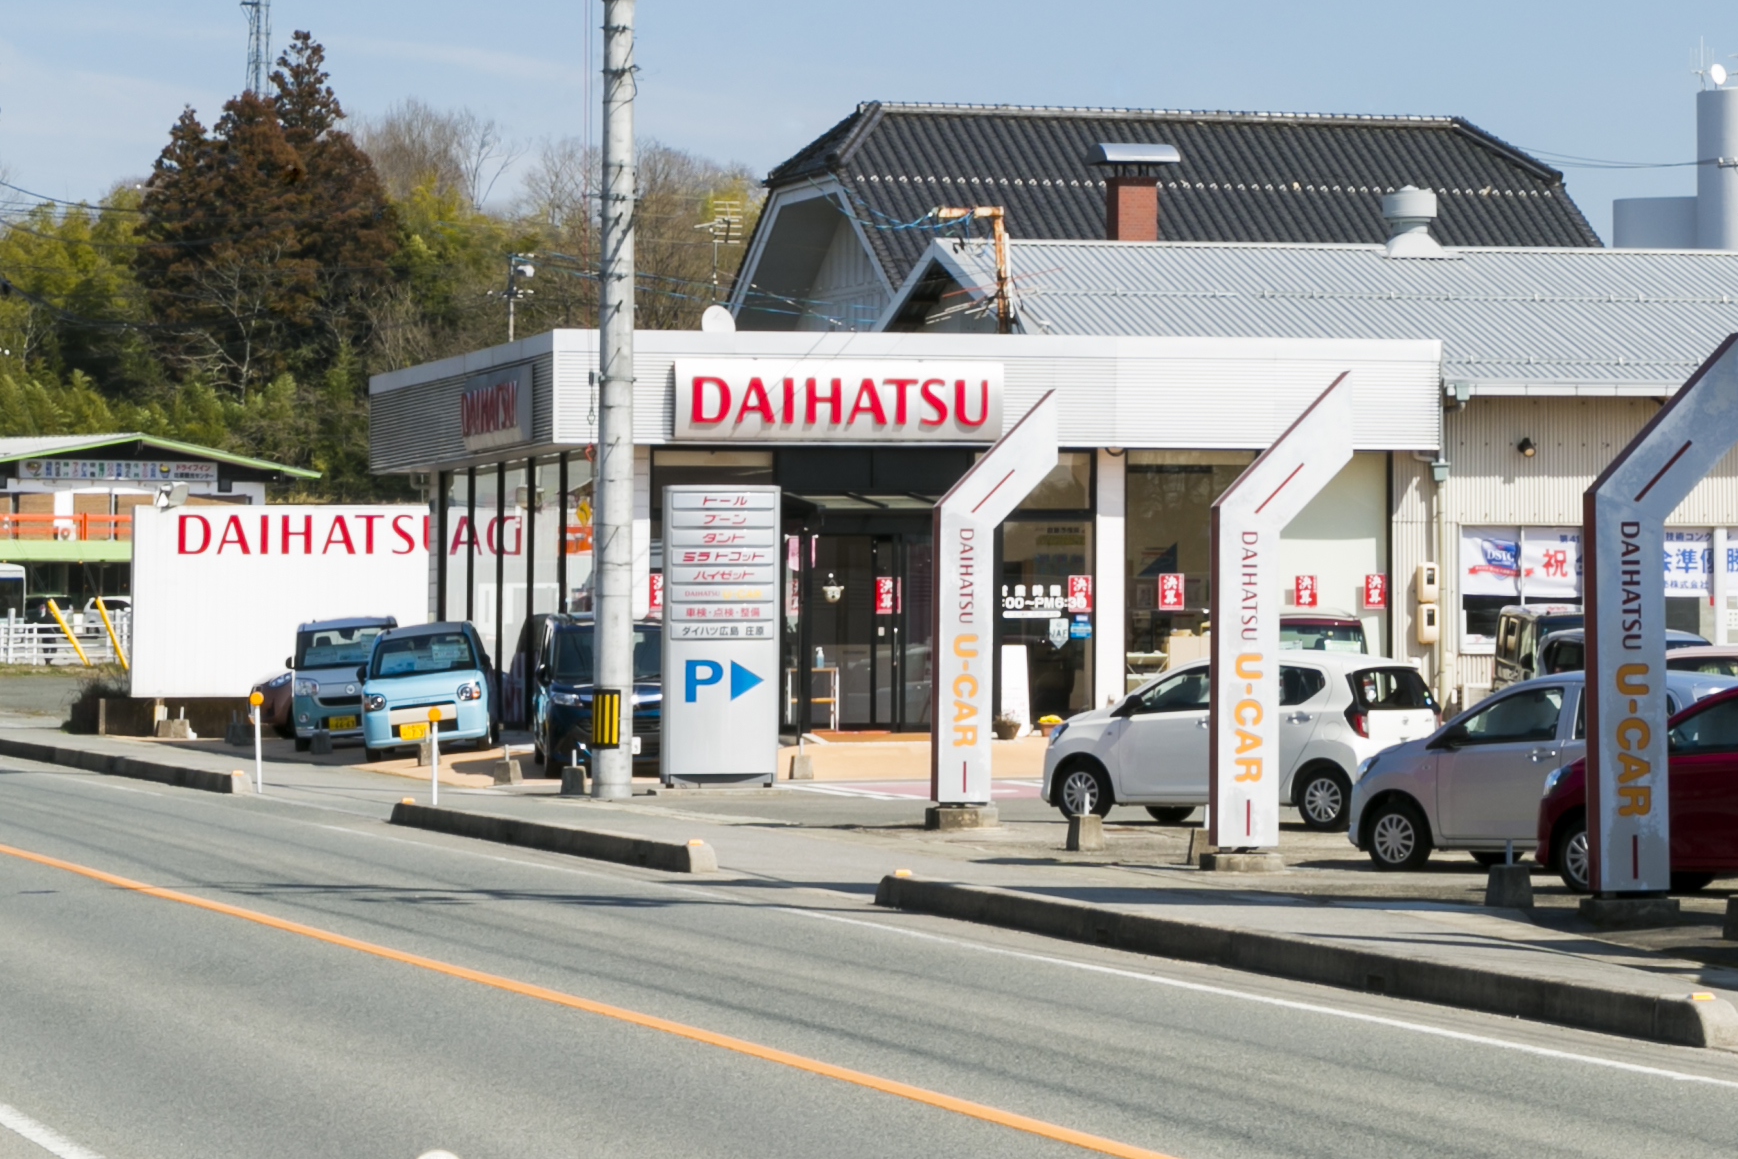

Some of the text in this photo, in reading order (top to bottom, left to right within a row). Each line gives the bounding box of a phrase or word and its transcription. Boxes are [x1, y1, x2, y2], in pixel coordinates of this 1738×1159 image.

[461, 381, 517, 437] DAIHATSU
[690, 375, 989, 427] DAIHATSU
[702, 496, 747, 506] トール
[177, 514, 430, 555] DAIHATS
[703, 514, 746, 525] ブーン
[702, 533, 745, 544] タント
[693, 571, 755, 581] ハイゼット
[1542, 549, 1569, 578] 祝
[684, 590, 721, 598] DAIHATSU
[682, 626, 765, 636] ダイハツ広島 庄原
[952, 528, 979, 747] DAIHATSU U-CAR
[1234, 531, 1263, 783] DAIHATSU U-CAR
[1615, 521, 1651, 817] DAIHATSU U-CAR
[685, 660, 724, 703] P
